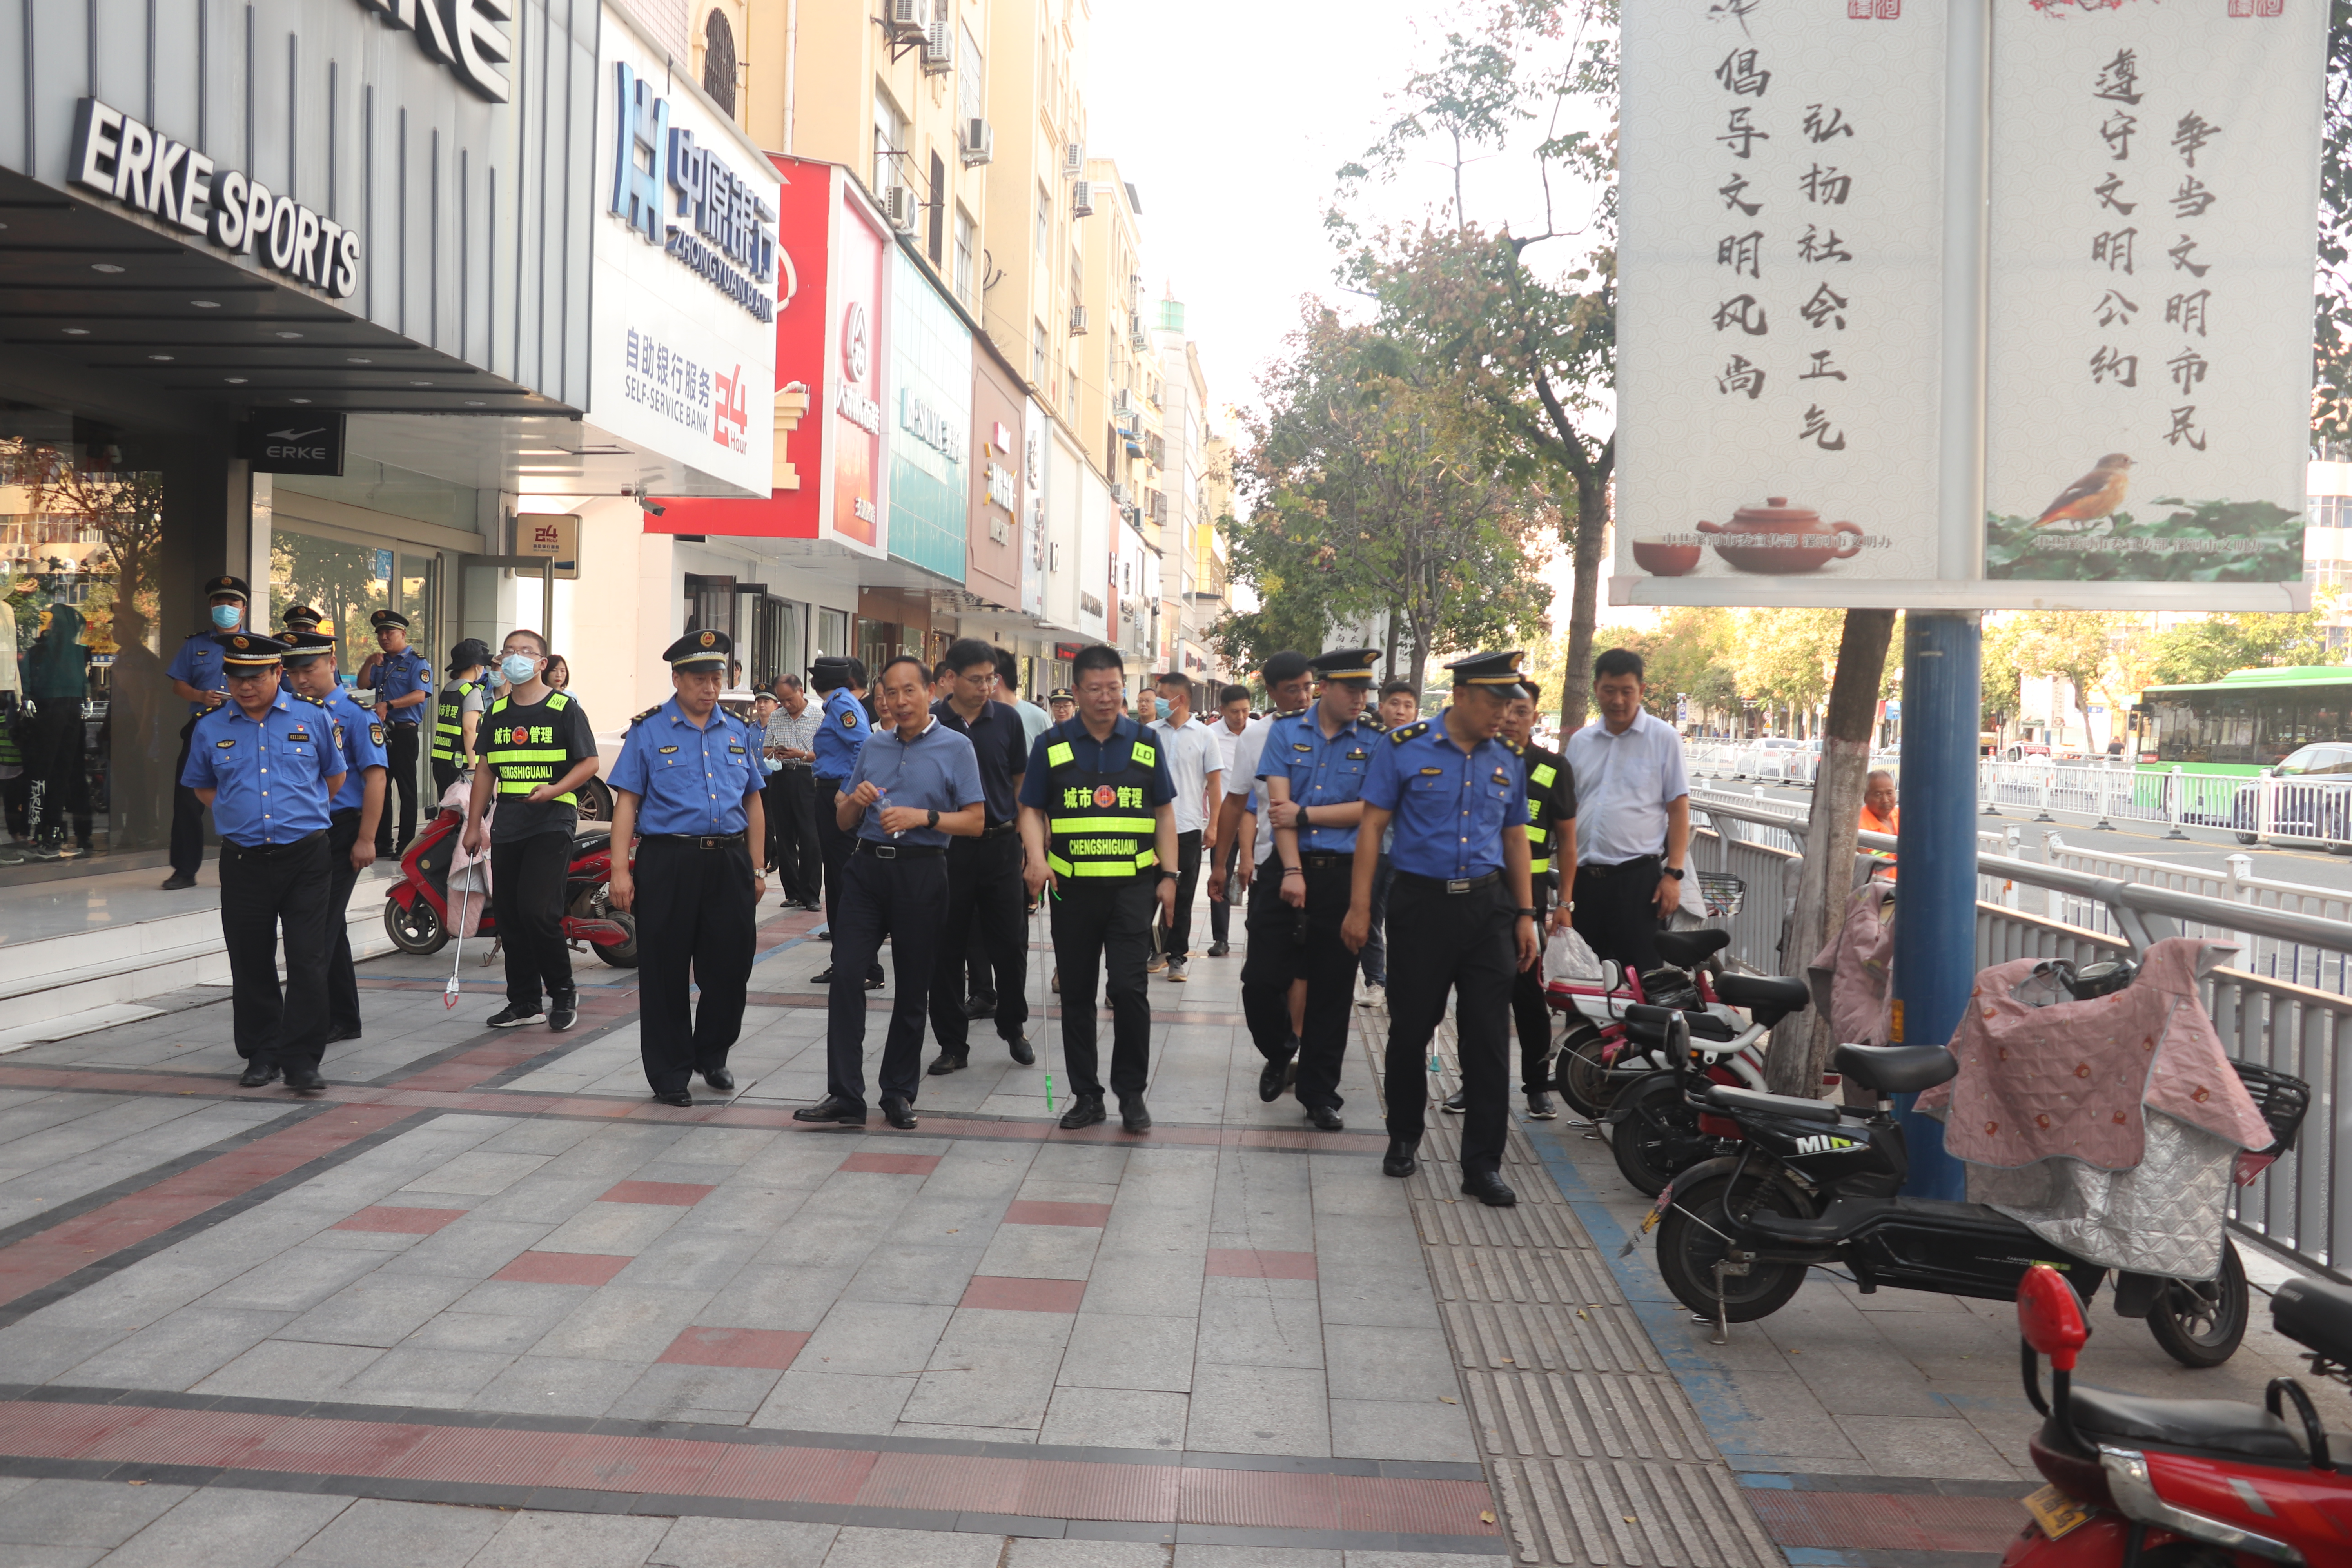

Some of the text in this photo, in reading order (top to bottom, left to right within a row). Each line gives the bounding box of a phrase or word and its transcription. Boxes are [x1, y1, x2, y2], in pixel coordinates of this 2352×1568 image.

[78, 99, 361, 298] ERKE SPORTS
[668, 127, 776, 283] 中原银行
[1711, 47, 1771, 399] 倡导文明风尚
[2090, 48, 2145, 387] 遵守文明公约
[671, 227, 773, 322] ZHONGYUAN BANK
[1797, 103, 1854, 450] 弘扬社会正气
[2163, 109, 2221, 451] 争当文明市民
[626, 326, 710, 408] 自助银行服务
[625, 374, 708, 435] SELF-SERVICE BANK
[713, 363, 747, 448] 24
[837, 377, 880, 435] 人本帆布鞋
[267, 446, 326, 459] ERKE
[731, 430, 747, 456] Hour
[535, 525, 558, 542] 24
[1662, 532, 1893, 548] 中共漯河市委宣传部 漯河市文明办
[2034, 535, 2263, 552] 中共漯河市委宣传部 漯河市文明办
[494, 726, 553, 744] 城市 管理
[1136, 747, 1152, 760] LD
[499, 766, 553, 779] CHENGSHIGUANLI
[1063, 786, 1143, 808] 城市 管理
[1069, 838, 1138, 855] CHENGSHIGUANLI
